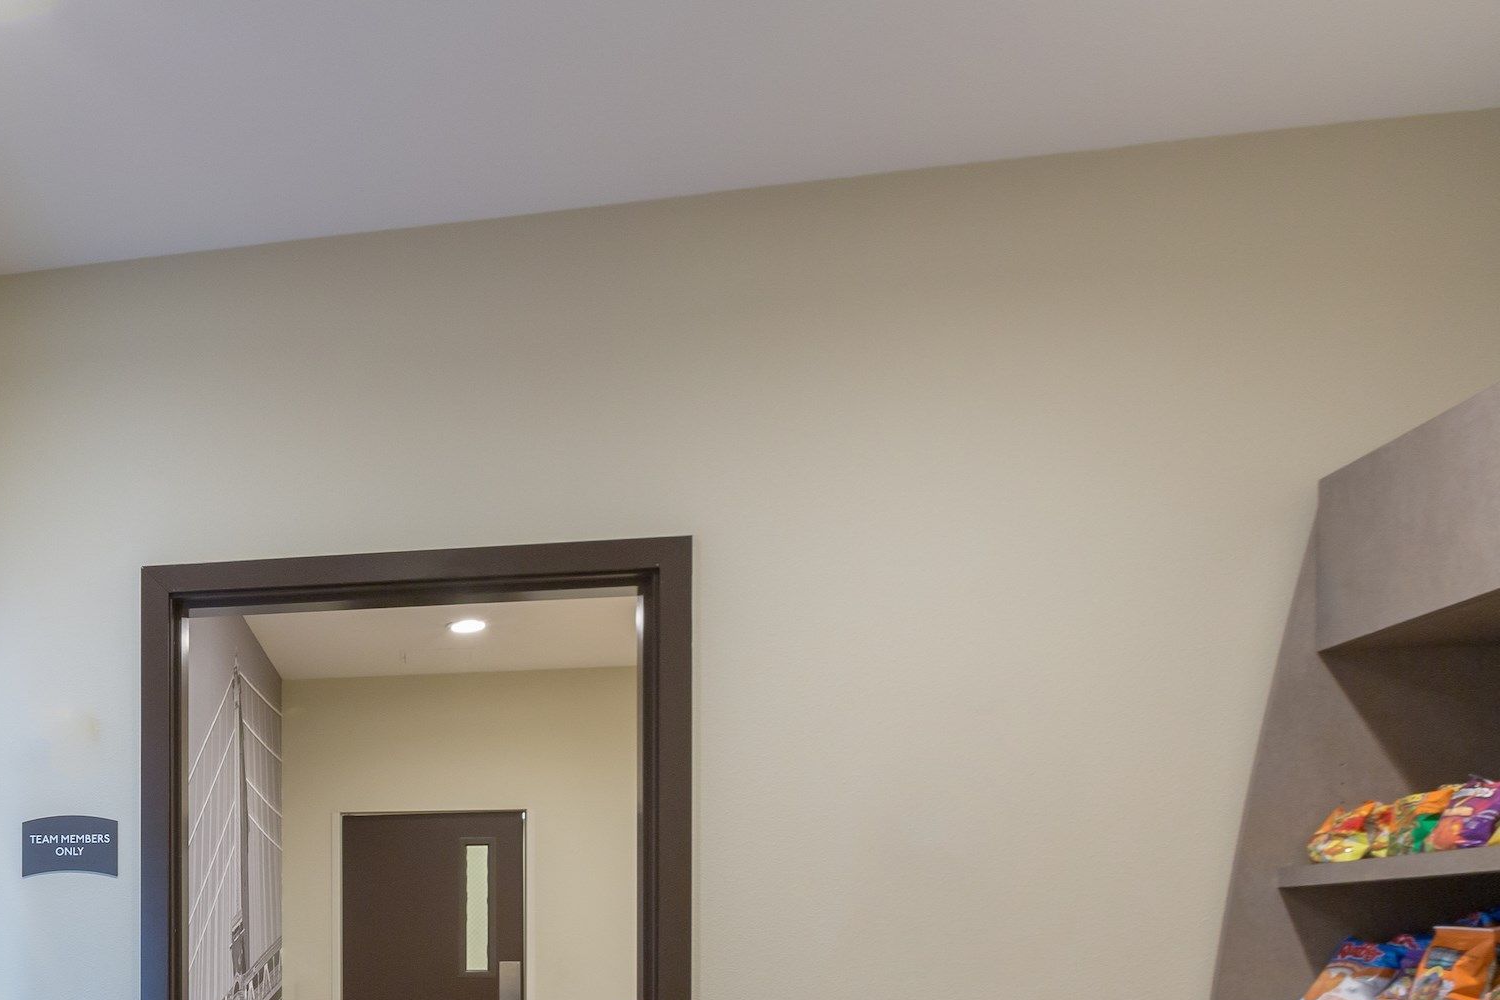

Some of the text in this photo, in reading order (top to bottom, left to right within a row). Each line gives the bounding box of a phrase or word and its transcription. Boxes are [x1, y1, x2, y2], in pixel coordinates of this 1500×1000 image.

[29, 833, 111, 844] TEAM MEMBERS
[55, 846, 84, 856] ONLY
